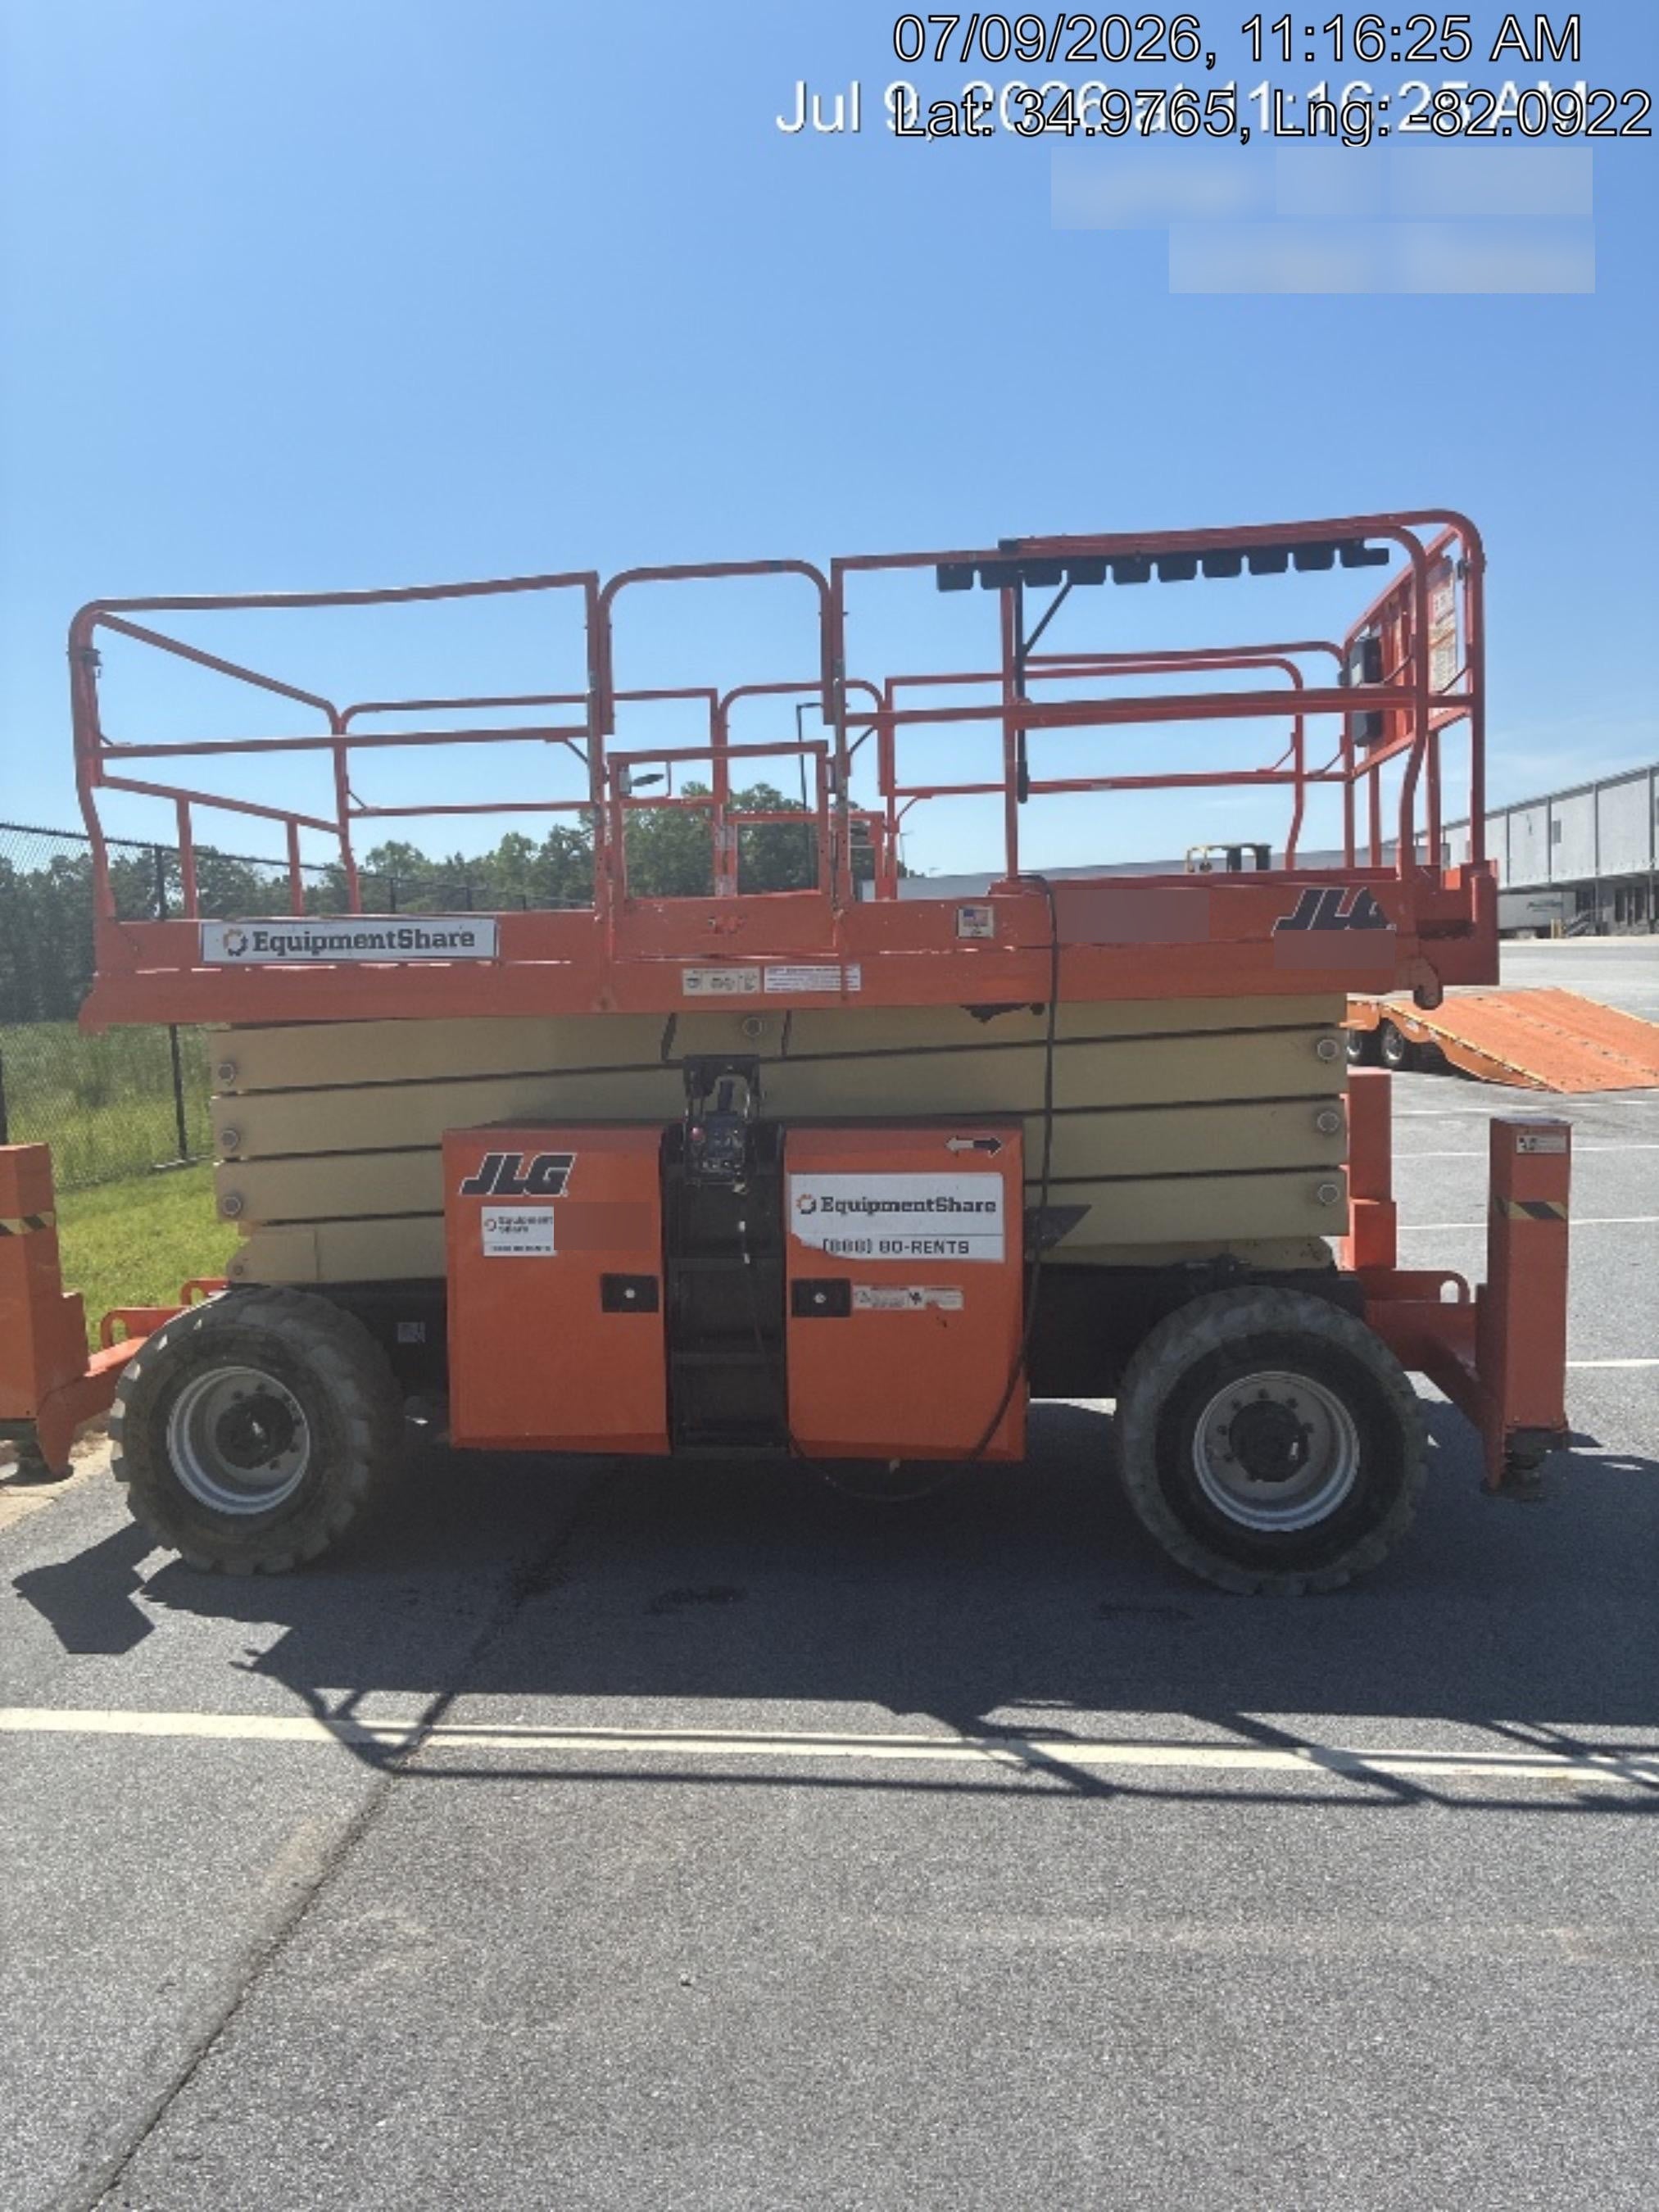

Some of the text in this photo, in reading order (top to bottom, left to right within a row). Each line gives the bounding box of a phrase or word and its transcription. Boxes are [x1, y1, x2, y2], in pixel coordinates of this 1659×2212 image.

[252, 928, 476, 957] EquipmentShare
[458, 1151, 577, 1197] JLG
[820, 1196, 997, 1216] EquipmentShare
